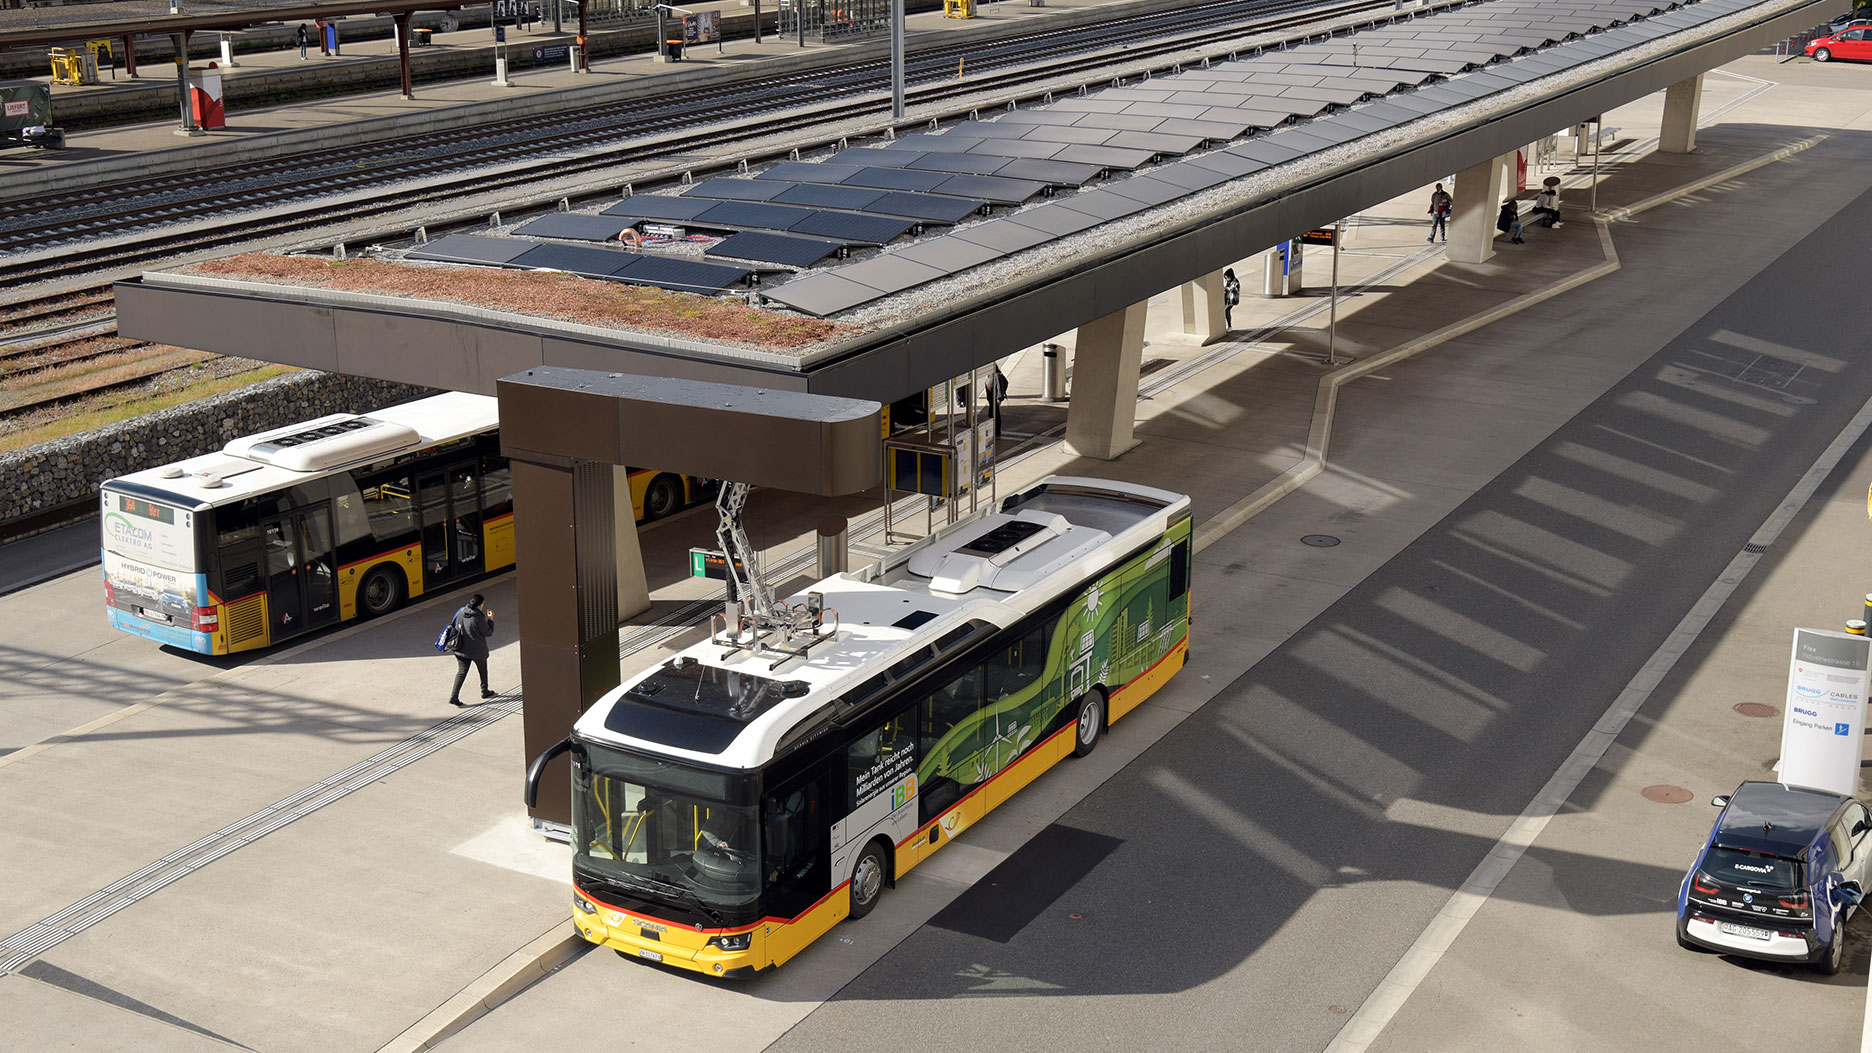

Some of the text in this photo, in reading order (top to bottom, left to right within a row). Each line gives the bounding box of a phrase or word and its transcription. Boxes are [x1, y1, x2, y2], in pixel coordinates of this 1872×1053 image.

[114, 522, 152, 542] ETACOM
[143, 542, 153, 550] AG
[695, 556, 703, 572] L
[121, 562, 146, 575] HYBRID
[152, 571, 177, 583] POWER
[1803, 644, 1817, 653] Flex
[1797, 685, 1821, 695] BRUGG
[1830, 691, 1858, 700] CABLES
[1793, 707, 1818, 717] BRUGG
[1792, 718, 1833, 731] Eingang Parken
[856, 742, 915, 786] Mein Tank reicht noch
[856, 776, 883, 797] Milliarden
[883, 767, 894, 779] von
[632, 917, 667, 933] SCANIA
